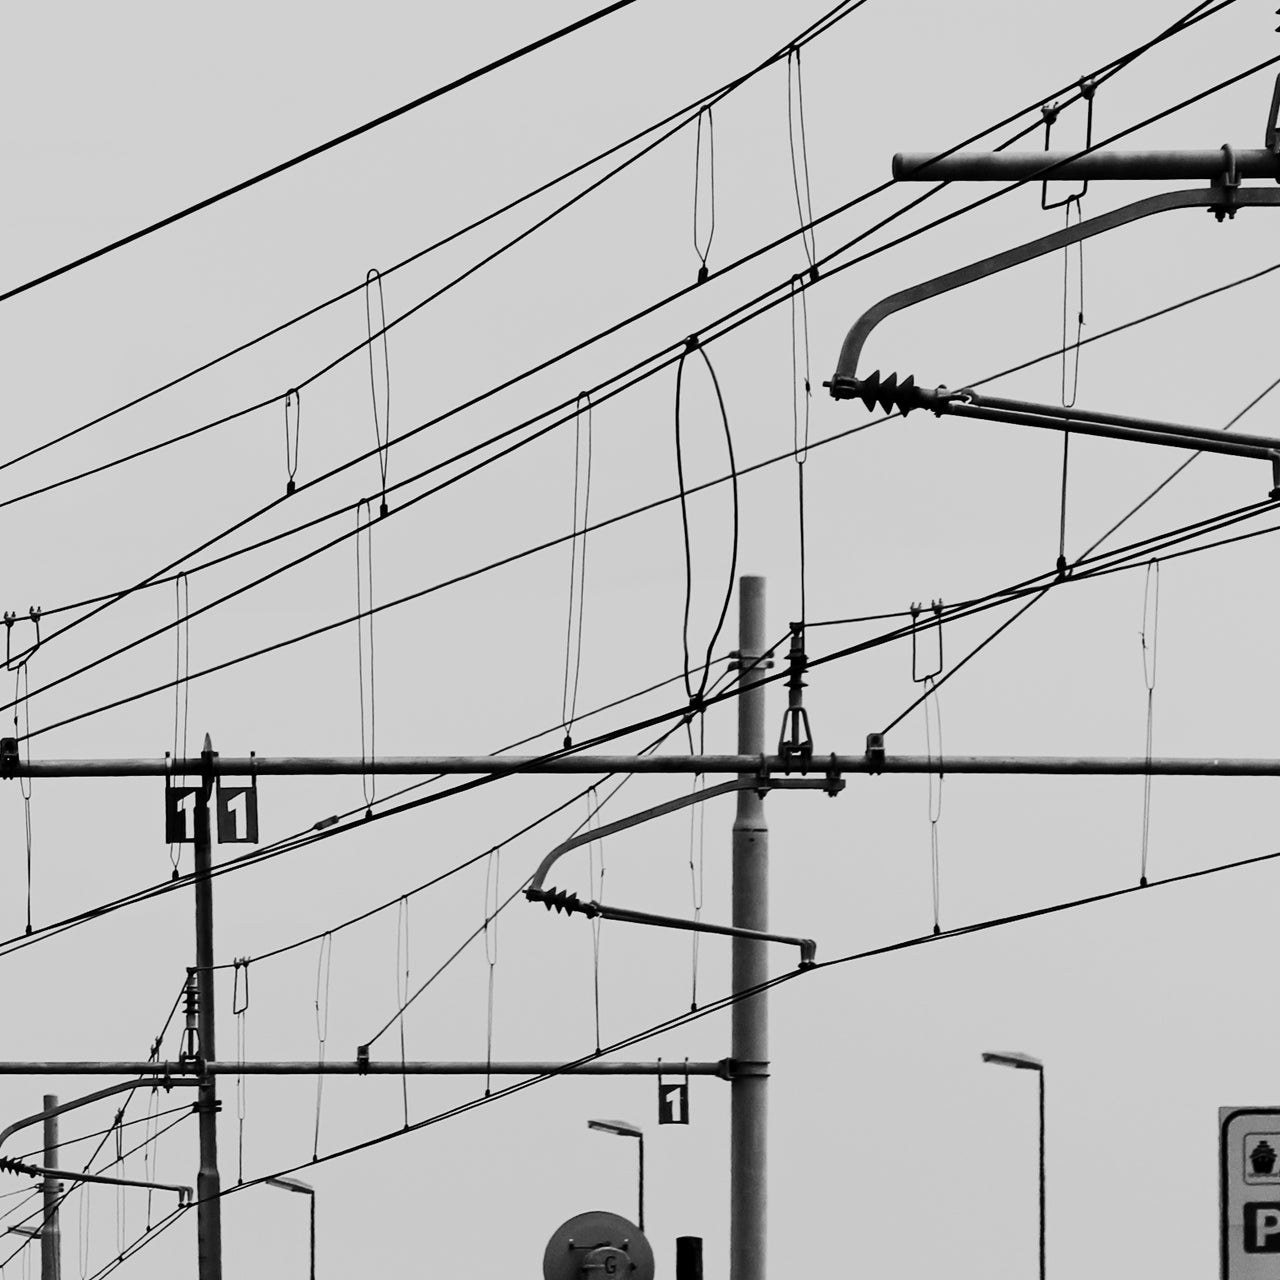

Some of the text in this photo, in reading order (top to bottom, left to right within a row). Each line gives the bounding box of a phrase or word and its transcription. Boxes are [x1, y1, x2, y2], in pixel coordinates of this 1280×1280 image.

[177, 791, 247, 839] 1 1
[666, 1087, 681, 1121] 1
[604, 1255, 616, 1274] G
